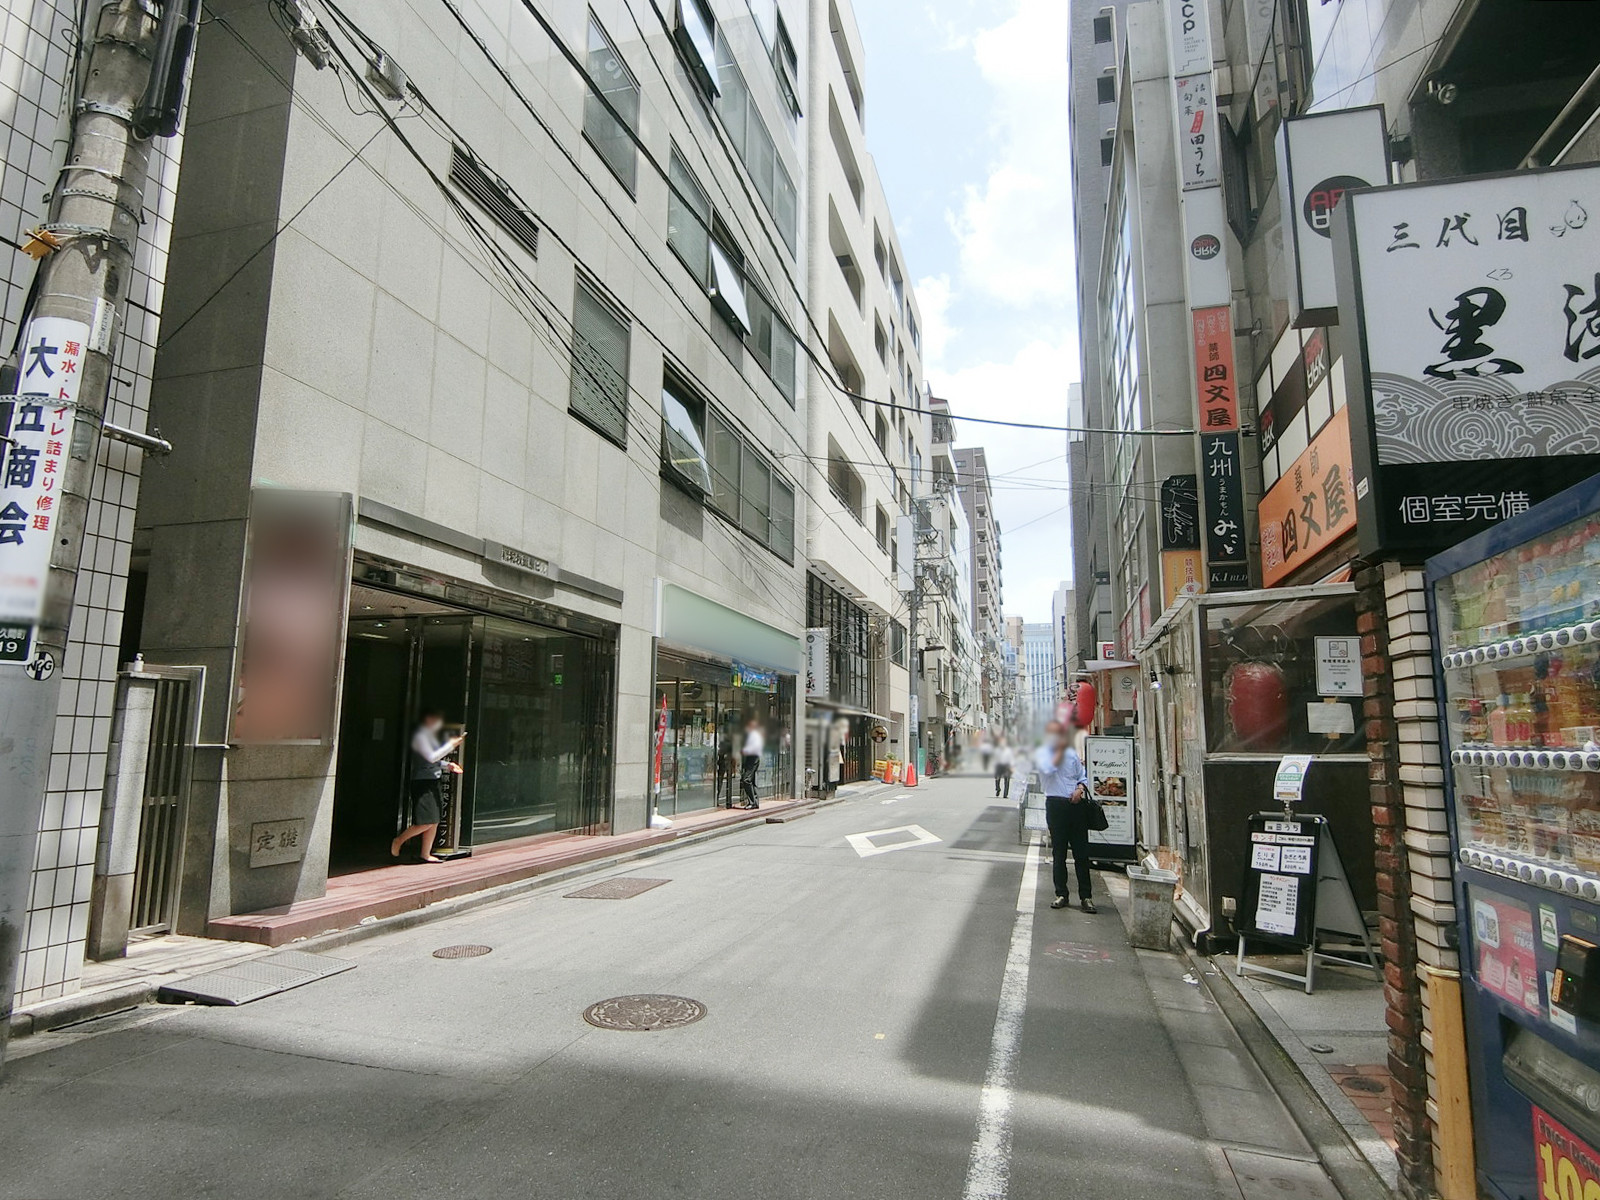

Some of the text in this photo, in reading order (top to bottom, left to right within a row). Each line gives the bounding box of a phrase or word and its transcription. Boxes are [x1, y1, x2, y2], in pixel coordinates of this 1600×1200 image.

[1386, 206, 1530, 253] 三代目
[1203, 364, 1232, 426] 四文屋
[1209, 437, 1233, 478] 九州
[1281, 463, 1349, 563] 四文屋
[1398, 490, 1531, 525] 個室完備
